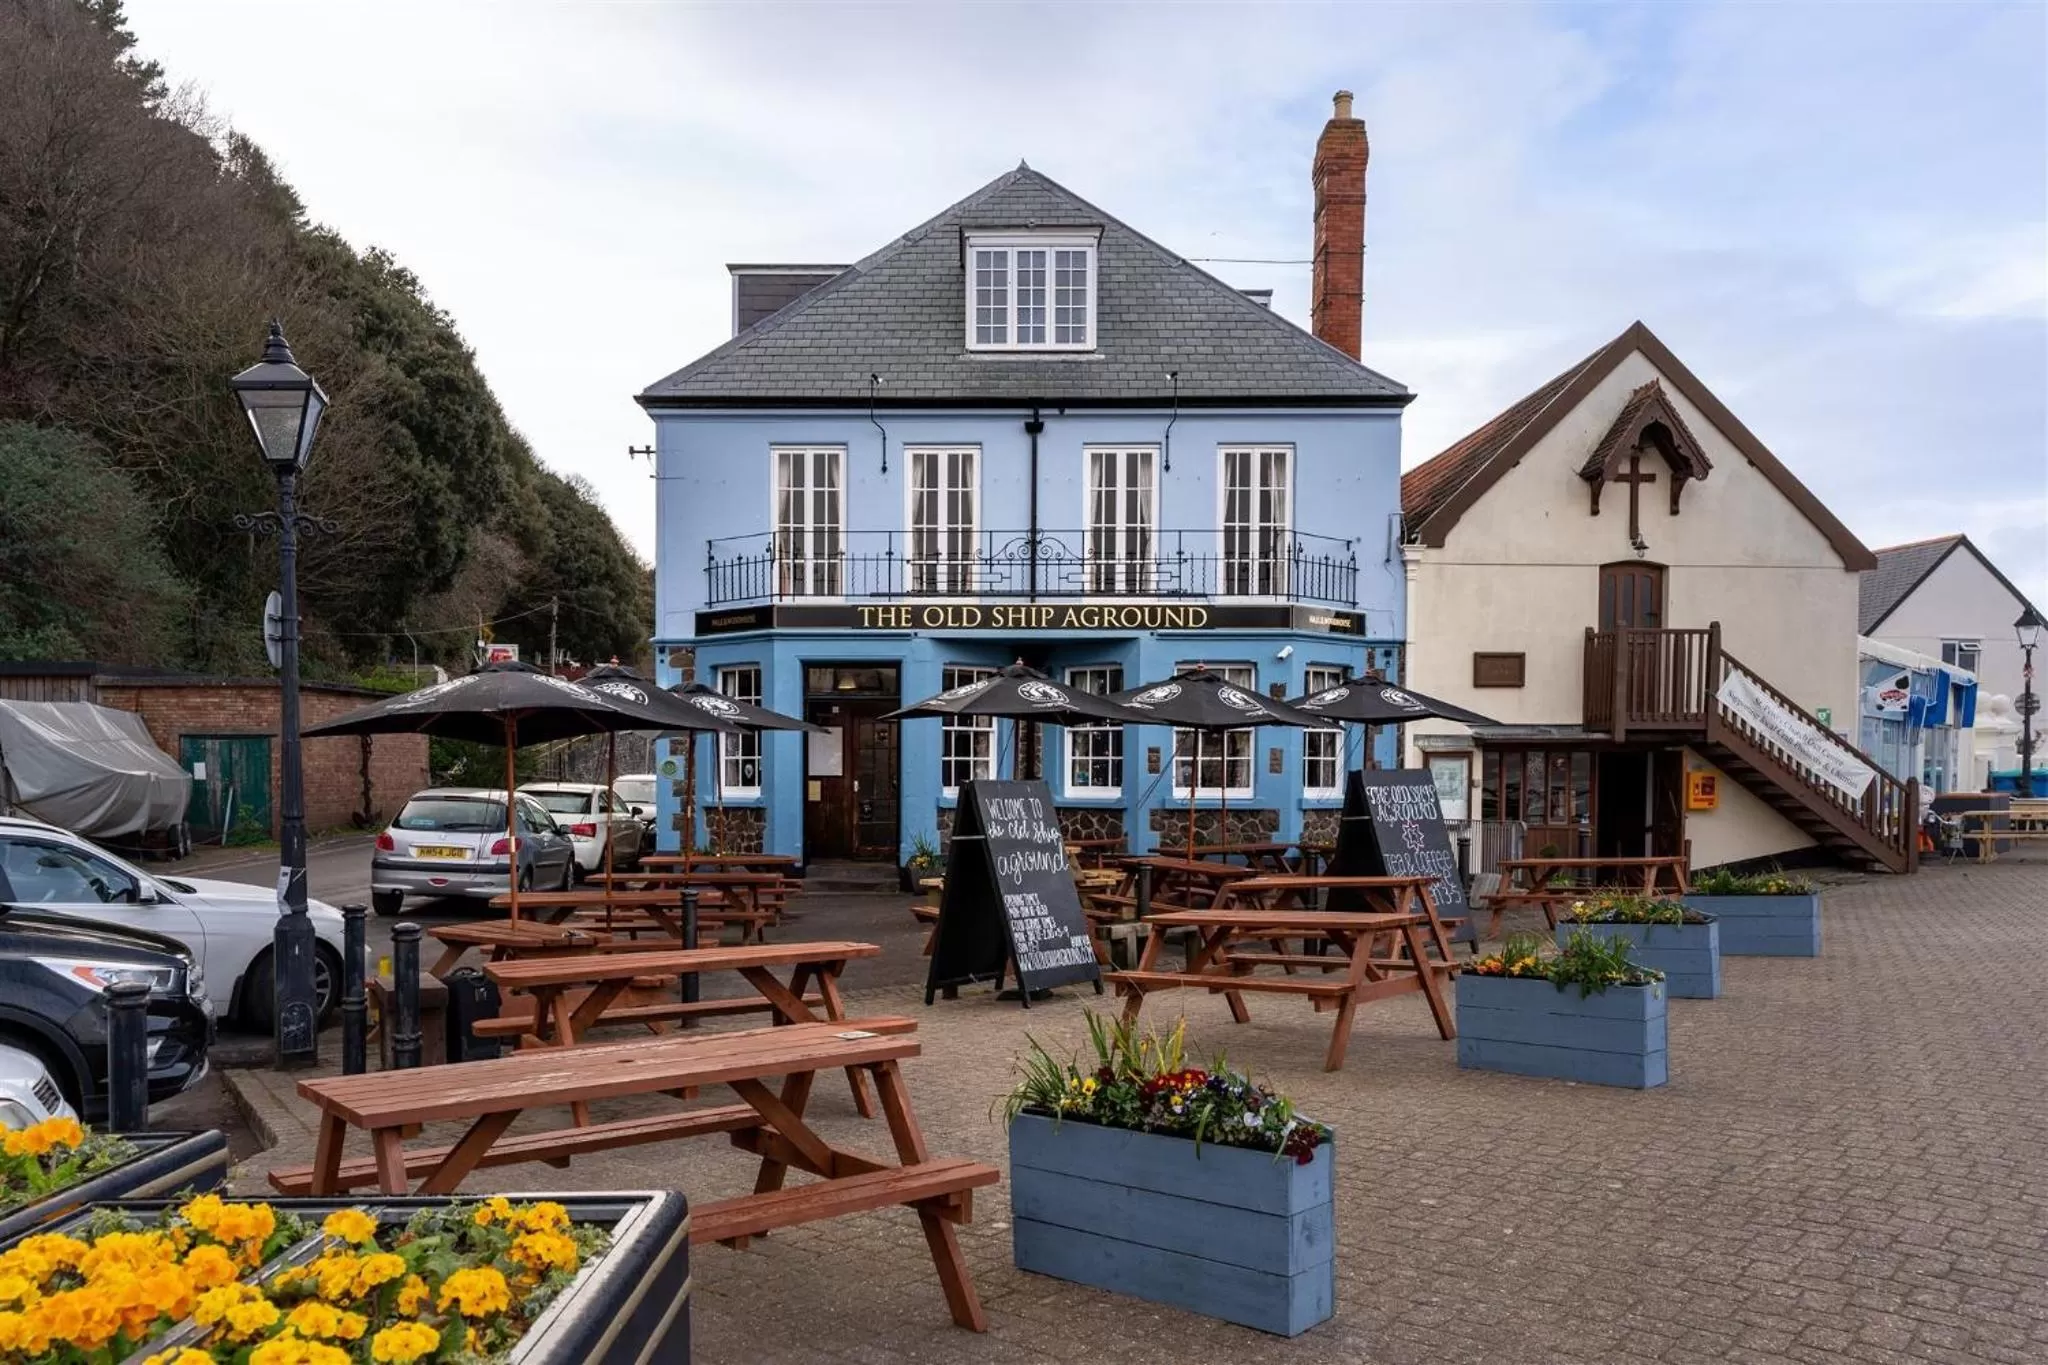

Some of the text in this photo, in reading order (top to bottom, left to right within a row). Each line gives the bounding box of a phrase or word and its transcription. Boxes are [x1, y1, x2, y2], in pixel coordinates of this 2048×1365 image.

[857, 606, 1208, 628] THE OLD SHIP AGROUND
[1366, 785, 1391, 805] THE
[1391, 785, 1410, 804] OLD
[985, 797, 1043, 821] WELCOME TO
[1377, 802, 1438, 825] AGROUND
[997, 840, 1069, 885] aground
